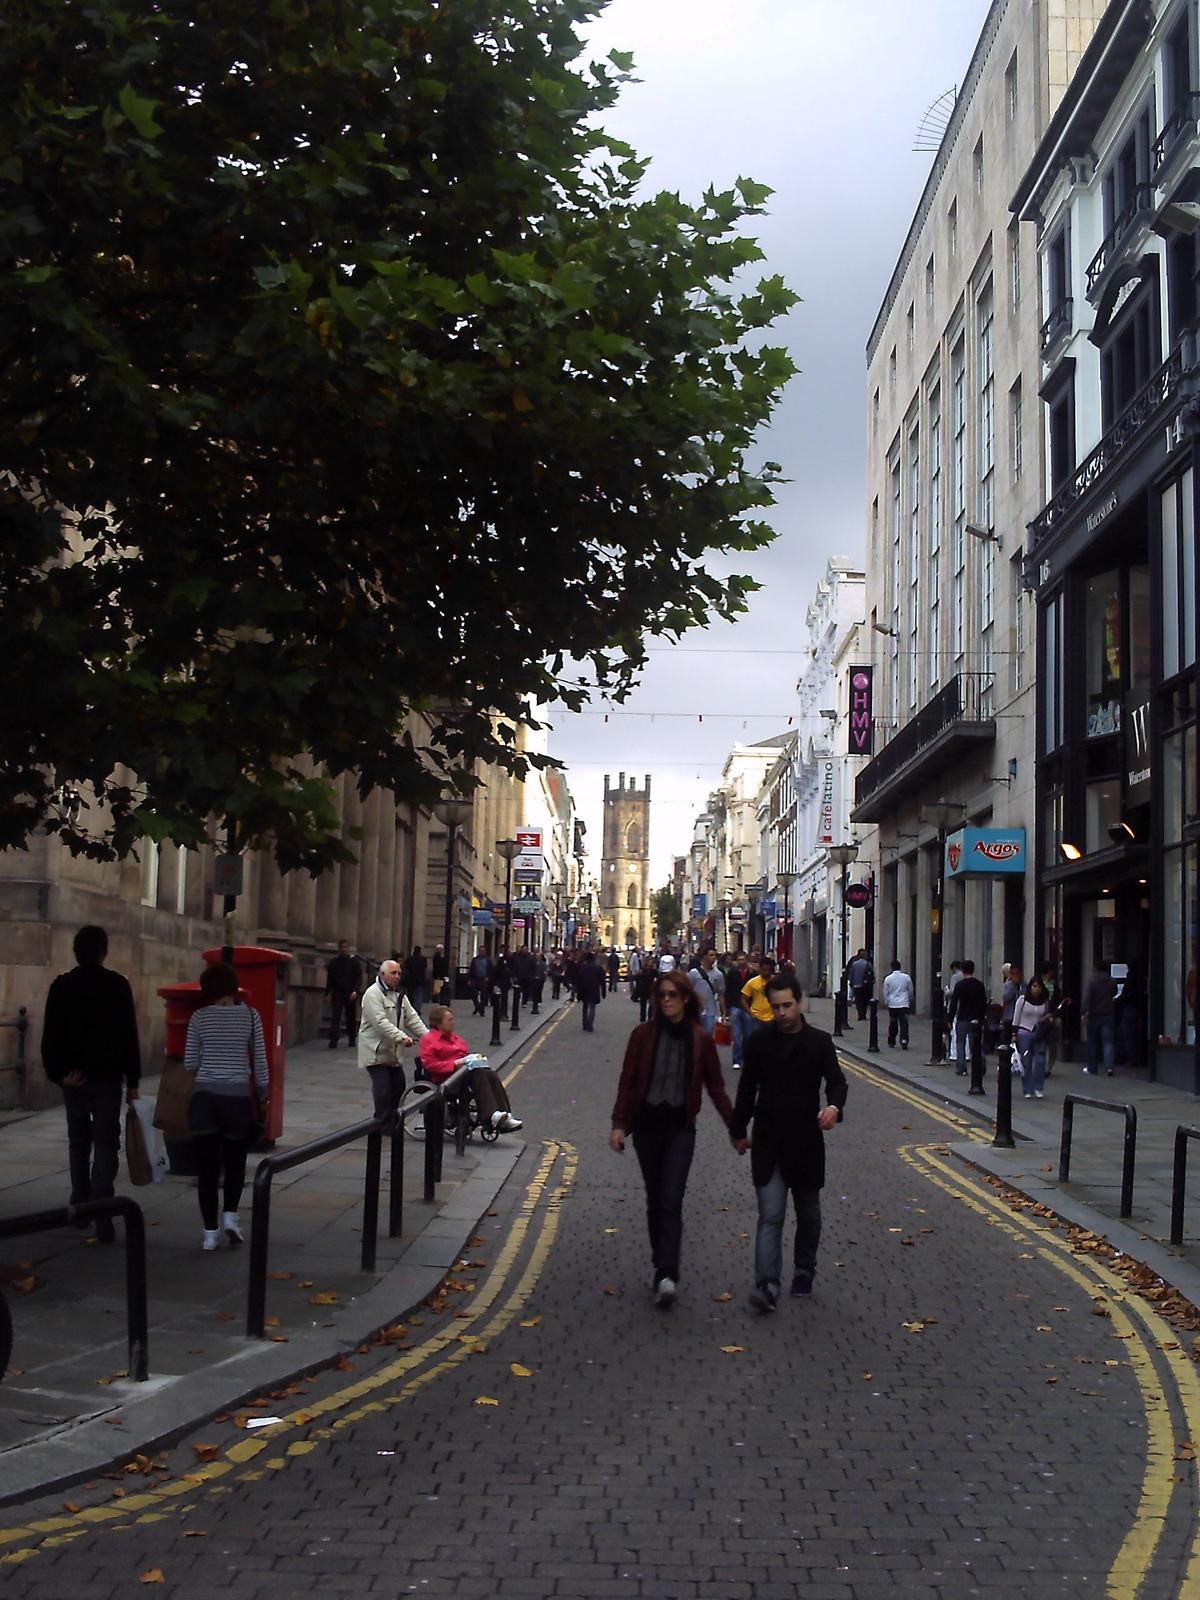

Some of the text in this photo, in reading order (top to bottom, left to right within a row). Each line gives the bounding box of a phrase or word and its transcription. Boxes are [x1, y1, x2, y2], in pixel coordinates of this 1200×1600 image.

[1165, 415, 1184, 453] 14
[1086, 491, 1117, 533] Waterstone's
[1039, 559, 1050, 586] 16
[852, 692, 869, 748] HMV
[1131, 701, 1151, 757] W
[972, 840, 1021, 861] Argos
